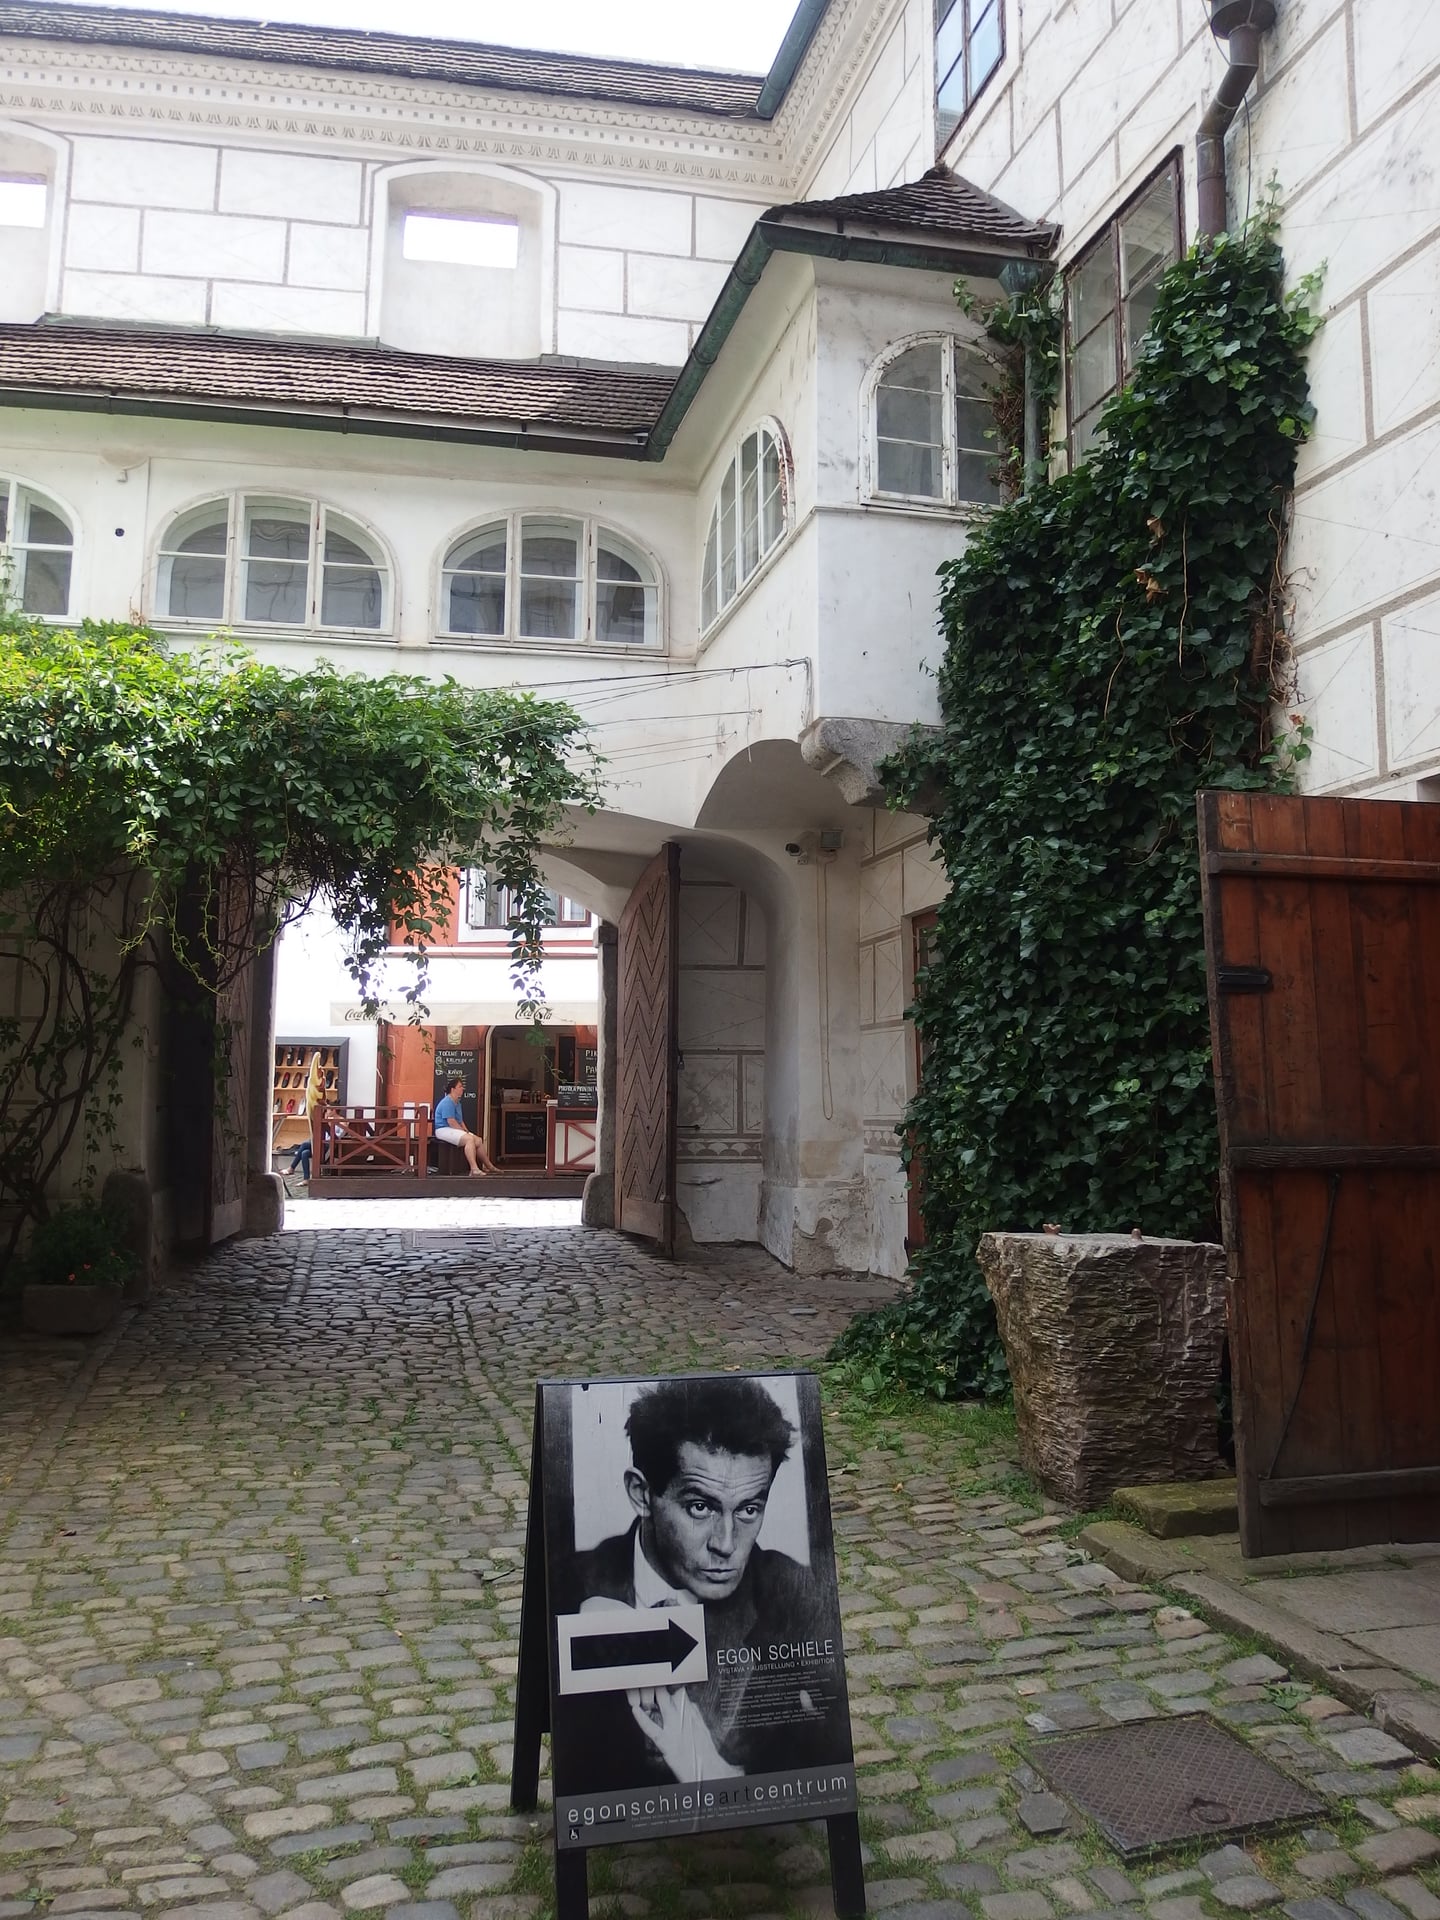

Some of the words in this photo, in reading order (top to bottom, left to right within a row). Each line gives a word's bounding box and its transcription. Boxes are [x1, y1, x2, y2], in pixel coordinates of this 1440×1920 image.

[717, 1647, 761, 1665] EGON
[769, 1639, 834, 1661] SCHIELE
[752, 1661, 794, 1671] AUSSTELLUNG
[801, 1657, 835, 1667] EXHIBITION
